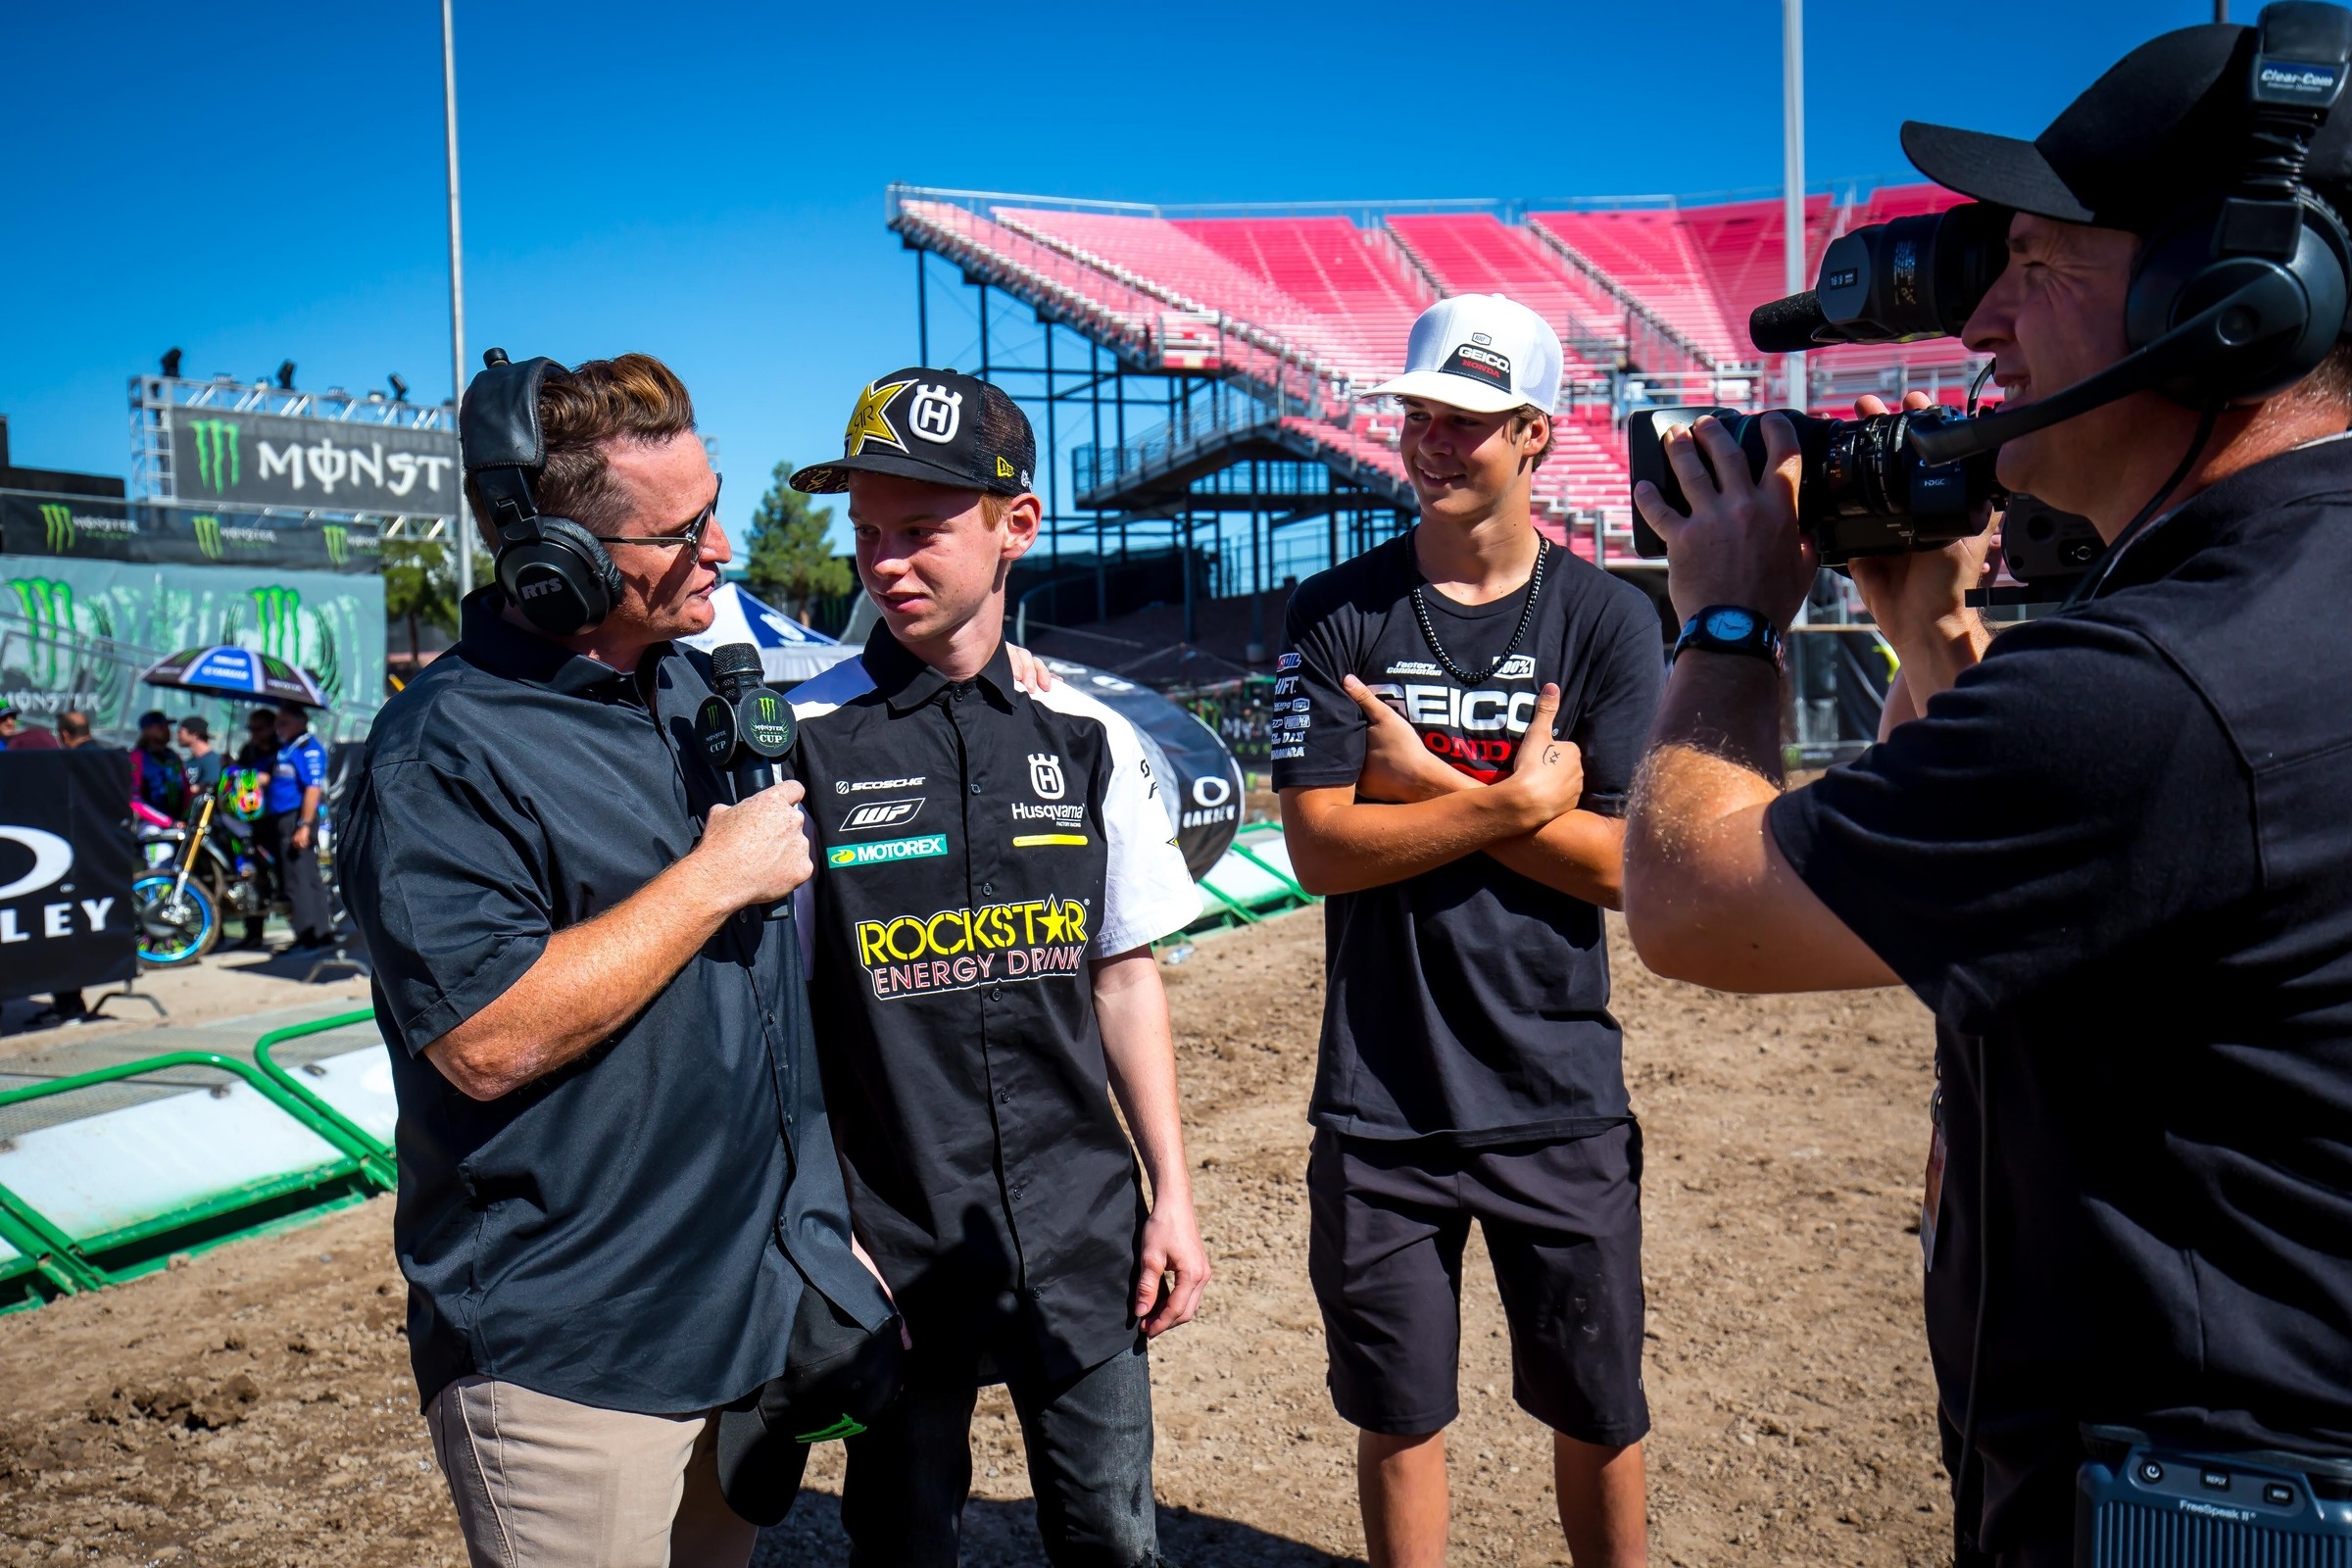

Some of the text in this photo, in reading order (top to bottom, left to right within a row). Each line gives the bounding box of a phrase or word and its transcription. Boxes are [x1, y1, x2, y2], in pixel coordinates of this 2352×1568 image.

[1461, 359, 1500, 378] HONDA
[520, 577, 563, 600] RTS
[1386, 666, 1443, 676] Connection
[1396, 661, 1437, 670] Factory
[755, 723, 785, 733] MONSTER
[710, 741, 725, 753] CUP
[759, 734, 783, 744] CUP
[1424, 733, 1517, 760] OND
[851, 777, 925, 791] SCOSCHE
[1011, 802, 1084, 820] Husqvarna
[857, 837, 943, 862] MOTOREX
[873, 945, 1082, 994] ENERGY DRINK
[2180, 1499, 2239, 1520] FreeSpeak
